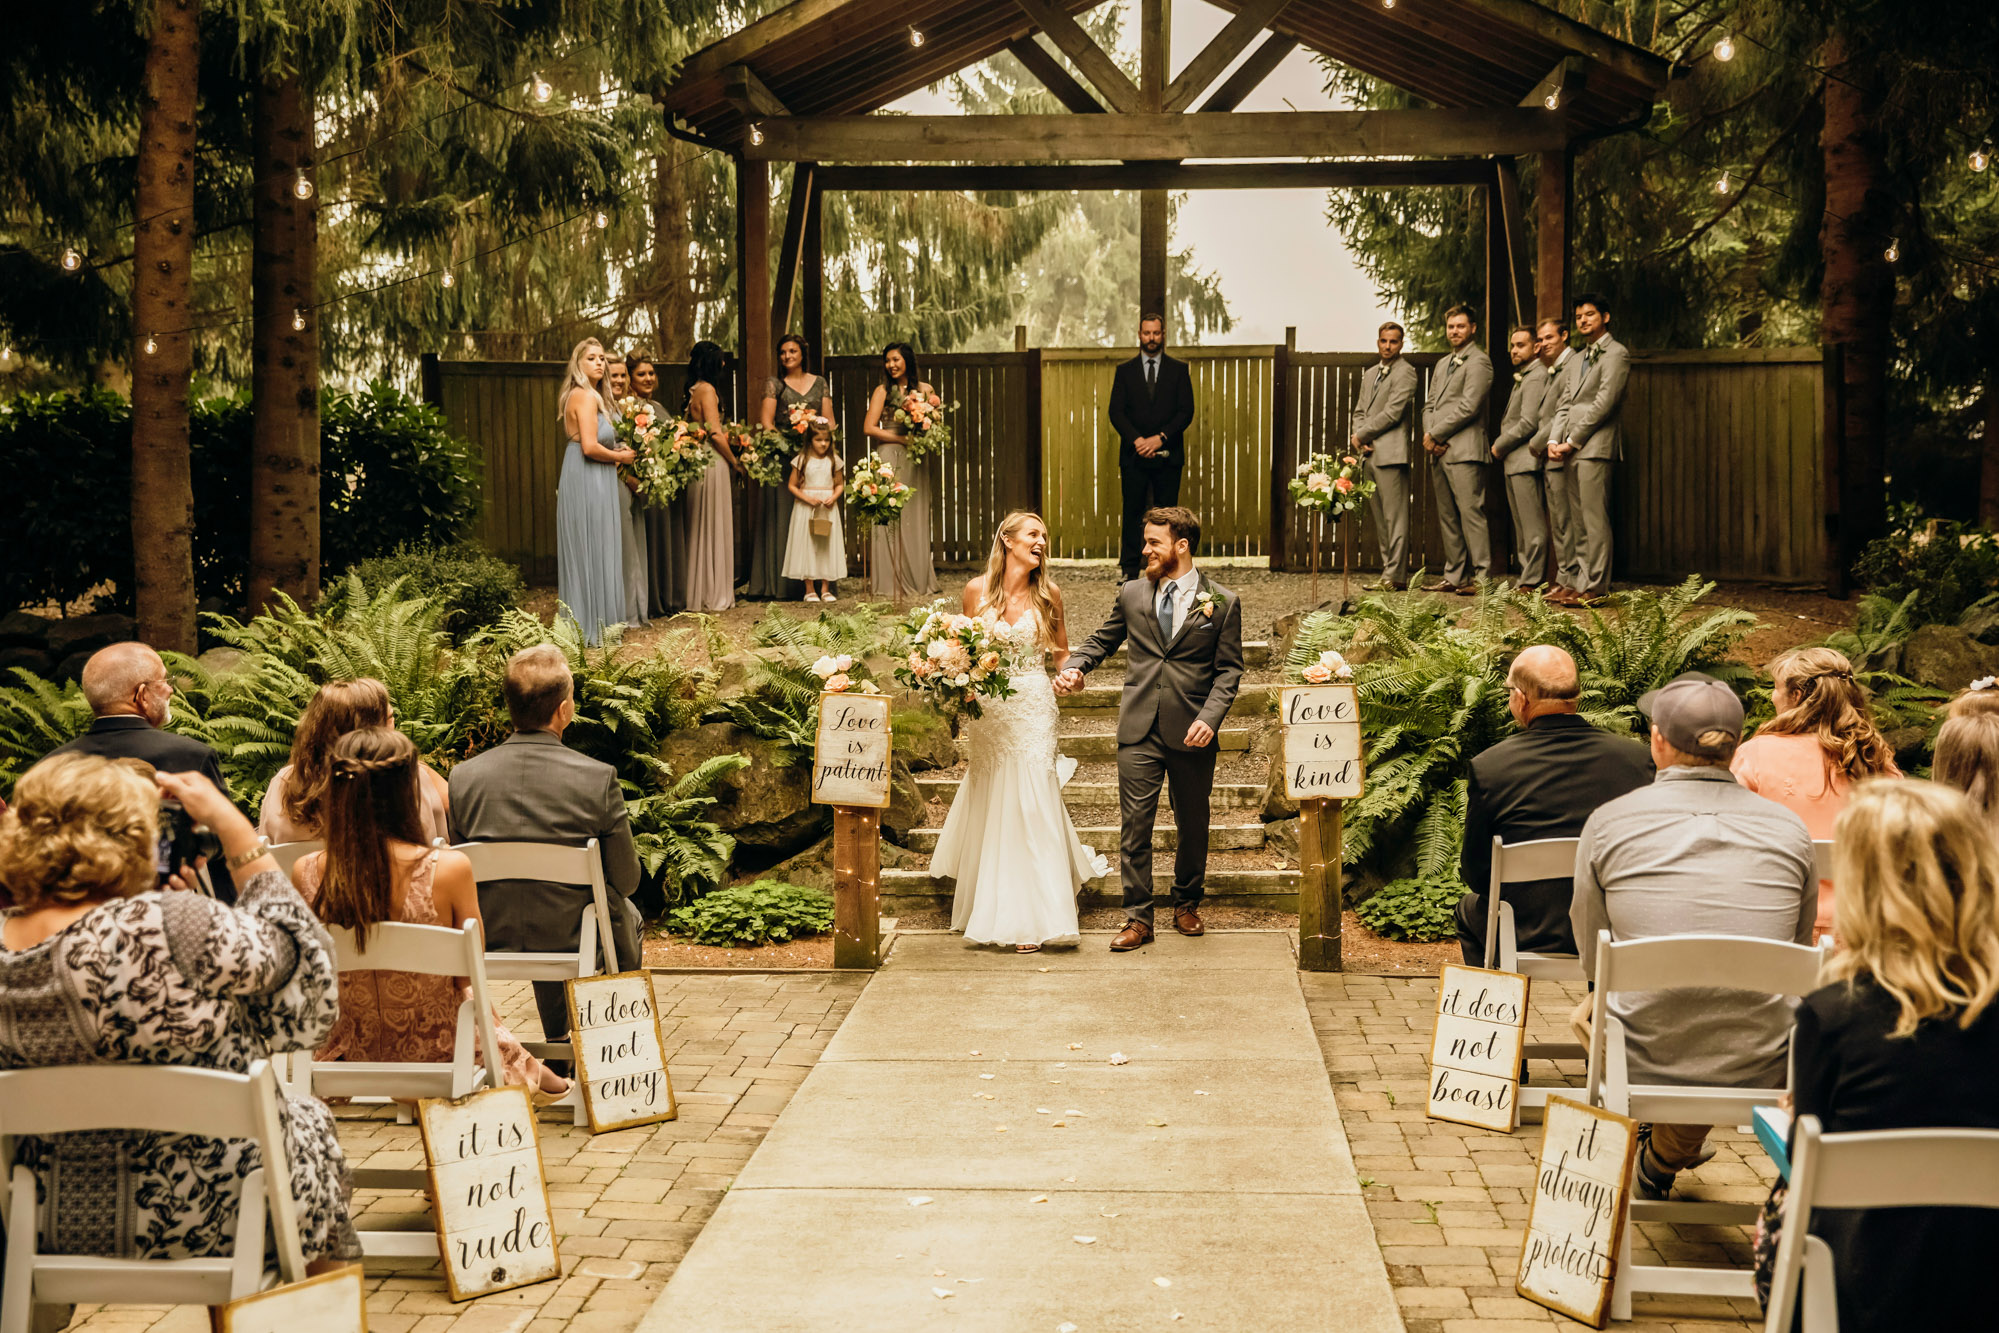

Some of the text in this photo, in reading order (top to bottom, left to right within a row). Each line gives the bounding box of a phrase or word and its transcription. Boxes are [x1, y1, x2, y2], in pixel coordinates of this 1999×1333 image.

[829, 706, 881, 731] Love
[1289, 694, 1353, 725] love
[848, 740, 865, 754] is
[1313, 733, 1336, 749] is
[814, 759, 885, 790] patient
[1294, 760, 1353, 789] kind
[580, 991, 651, 1027] it does
[1442, 988, 1522, 1023] it does
[601, 1030, 643, 1063] not
[1450, 1030, 1502, 1060] not
[601, 1071, 663, 1106] envy
[1432, 1070, 1511, 1110] boast
[458, 1122, 527, 1159] it is
[1575, 1118, 1600, 1161] it
[467, 1165, 523, 1208] not
[1540, 1150, 1616, 1238] always
[456, 1206, 550, 1270] rude
[1519, 1232, 1601, 1286] protects
